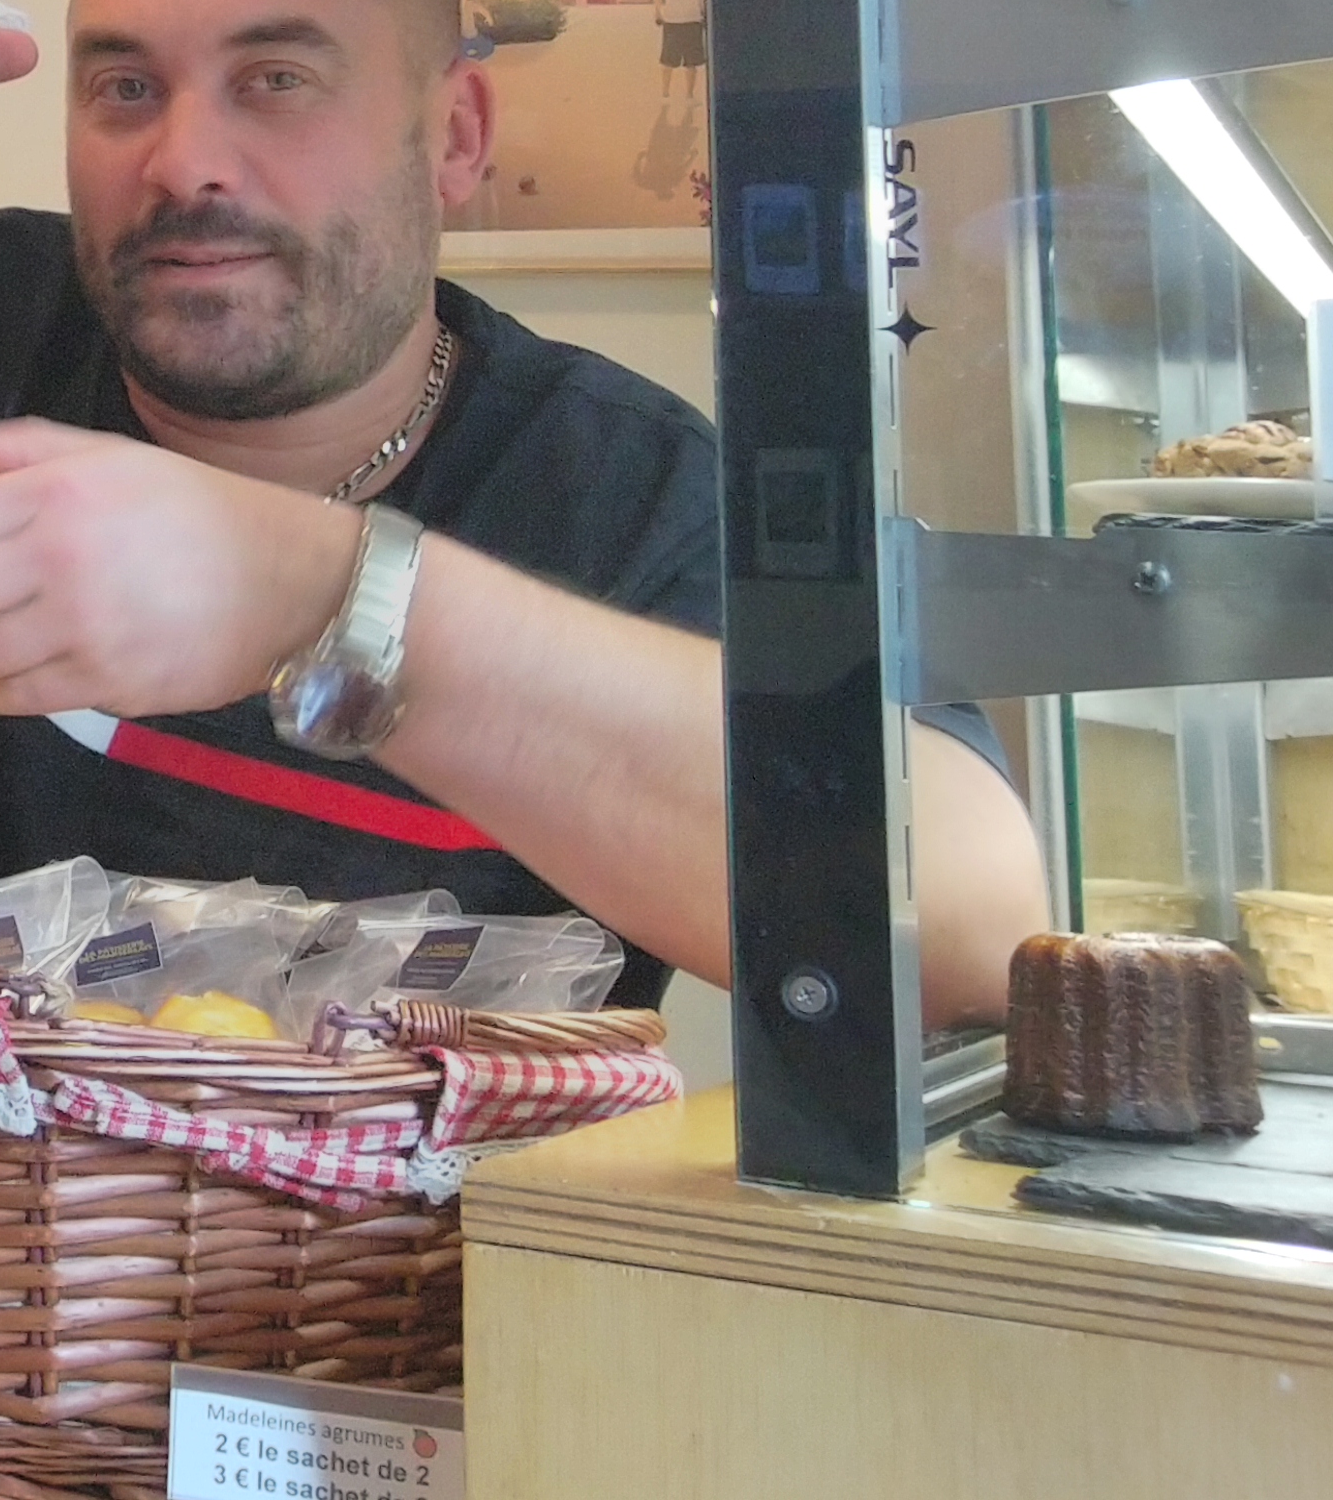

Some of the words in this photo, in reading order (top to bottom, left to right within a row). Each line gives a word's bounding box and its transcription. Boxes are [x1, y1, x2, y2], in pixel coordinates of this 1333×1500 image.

[207, 1403, 316, 1436] Madeleines
[320, 1421, 406, 1451] agrumes
[214, 1465, 226, 1484] 3
[235, 1468, 248, 1488] €
[258, 1471, 276, 1492] le
[215, 1434, 227, 1453] 2
[236, 1437, 249, 1457] €
[258, 1440, 278, 1462] le
[287, 1448, 369, 1477] sachet
[378, 1459, 407, 1483] de
[416, 1466, 429, 1486] 2
